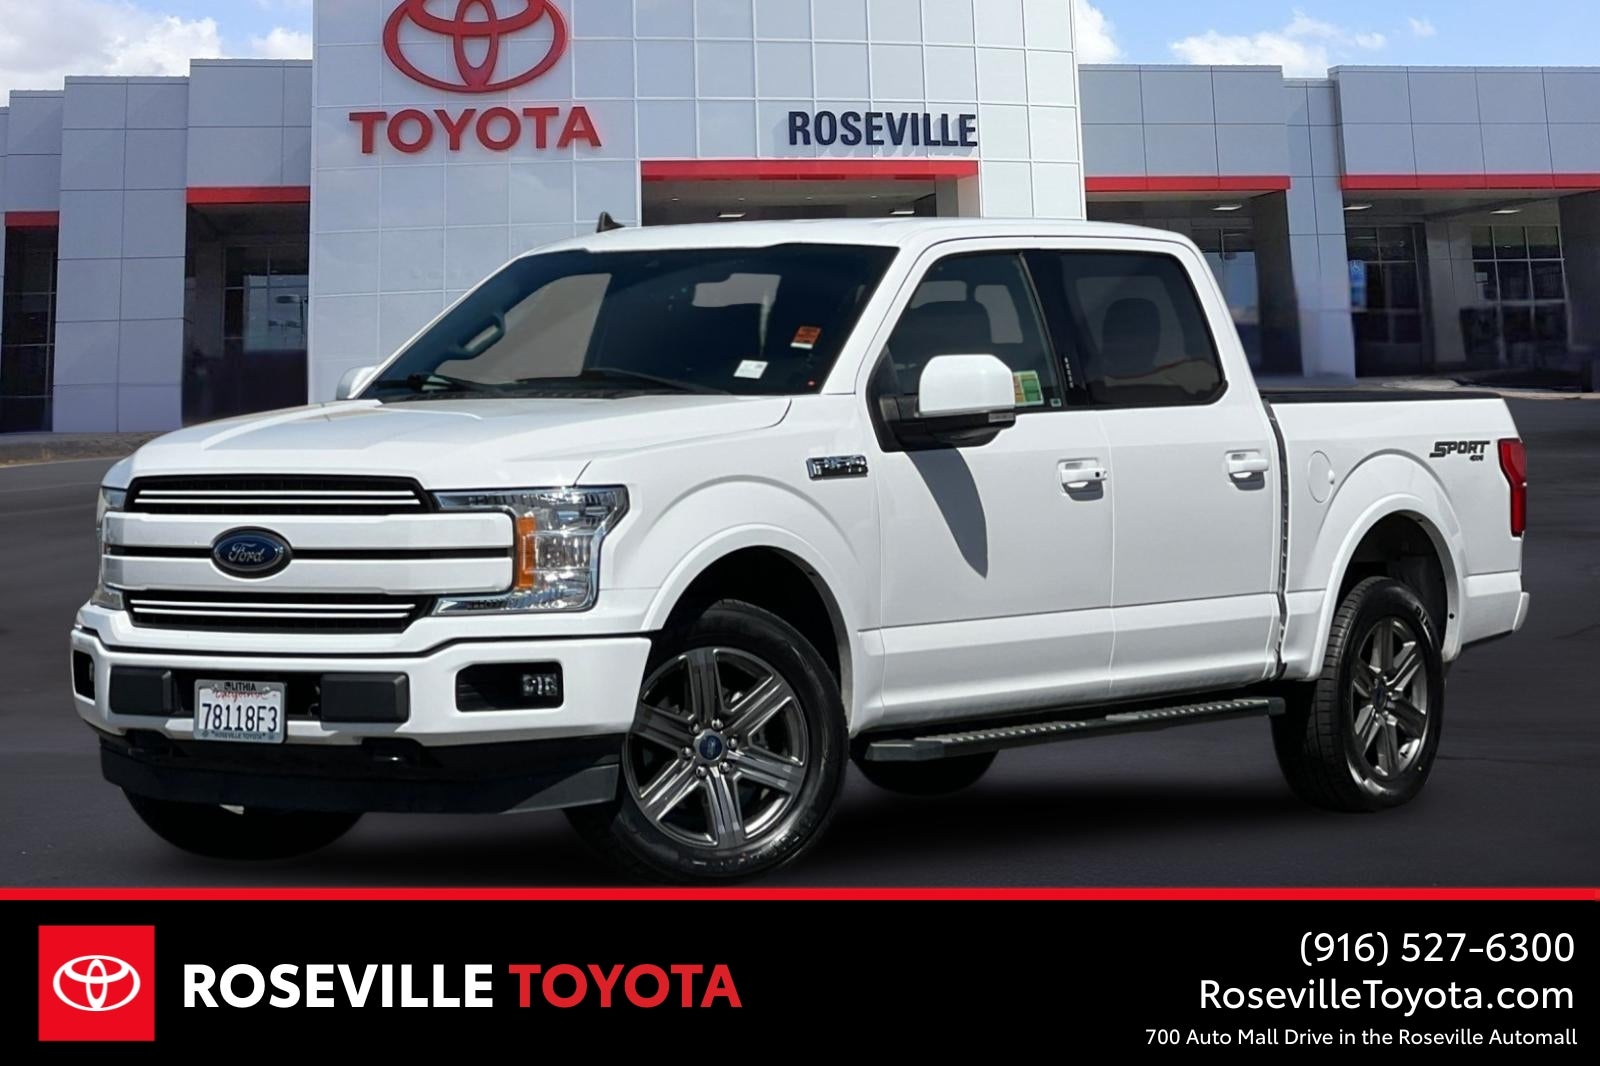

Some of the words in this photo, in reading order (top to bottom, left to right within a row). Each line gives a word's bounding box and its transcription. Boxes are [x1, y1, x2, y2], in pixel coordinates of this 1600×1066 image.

[349, 106, 602, 155] TOYOTA
[788, 111, 978, 148] ROSEVILLE
[1429, 440, 1490, 458] SPORT
[228, 542, 266, 562] Ford
[231, 682, 257, 691] LITHIA
[202, 703, 278, 732] 78118F3
